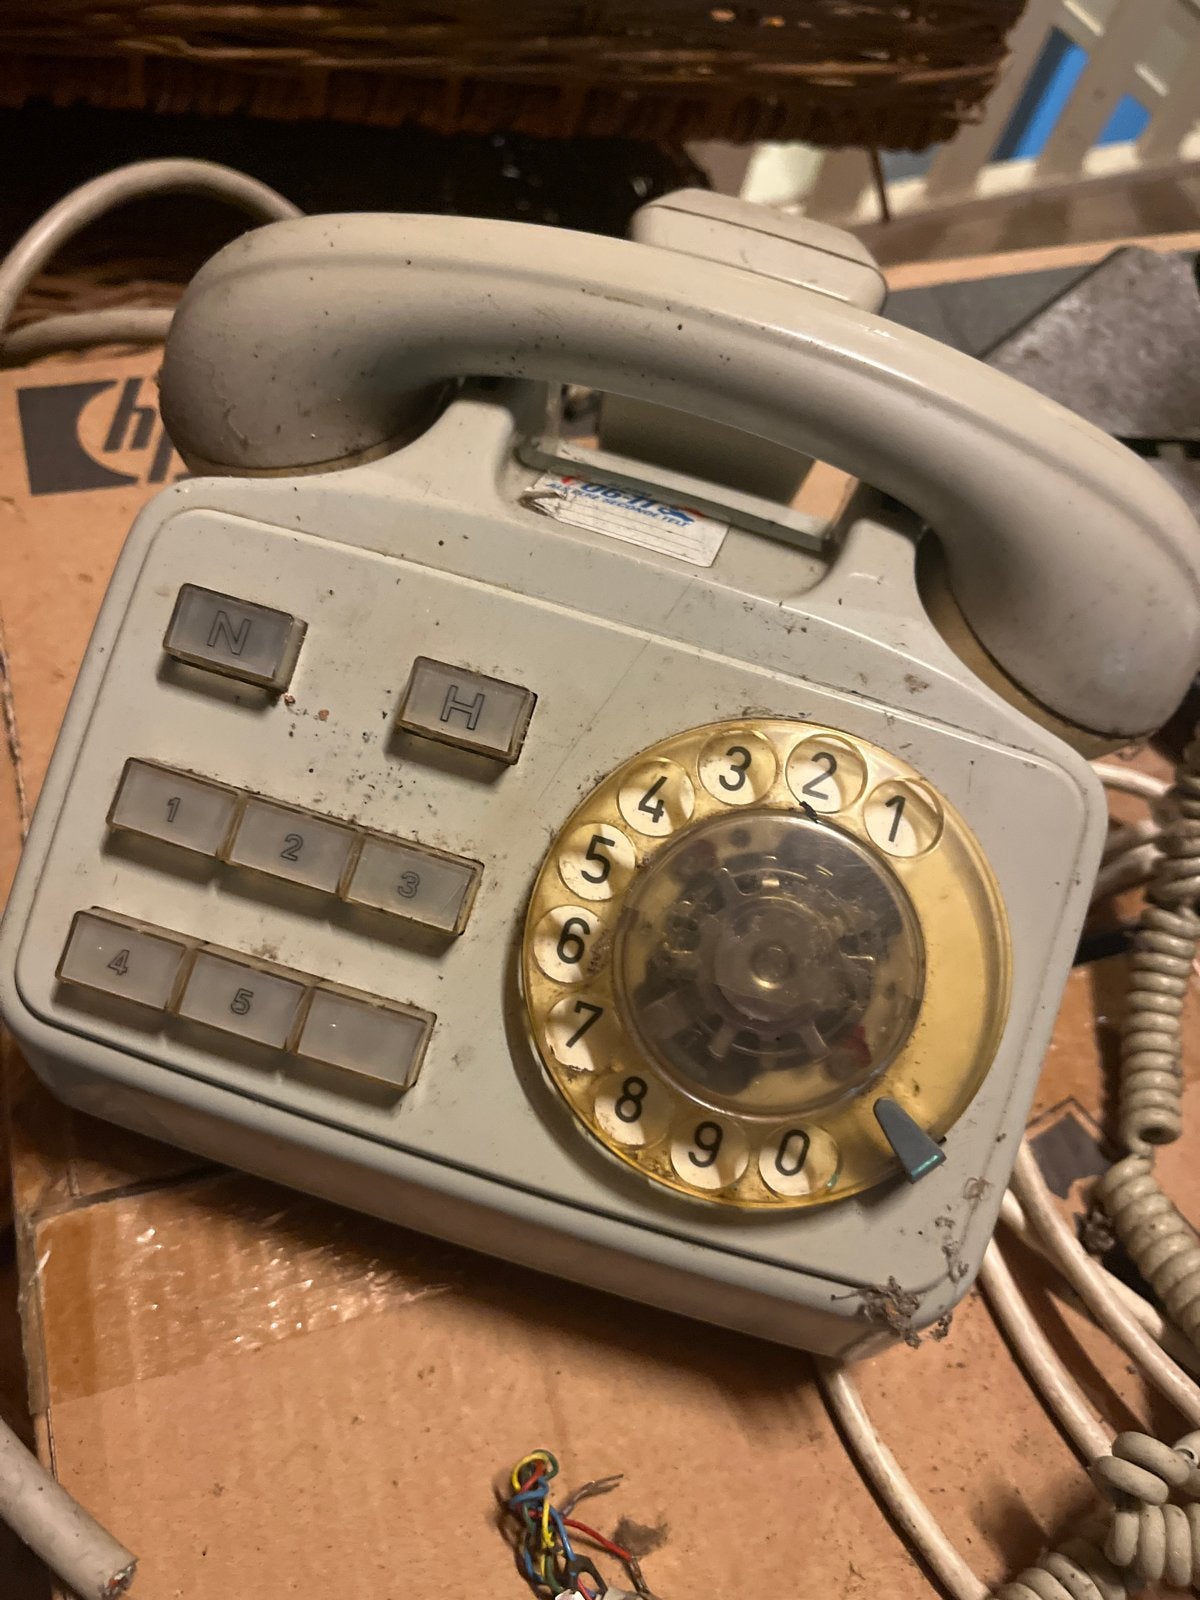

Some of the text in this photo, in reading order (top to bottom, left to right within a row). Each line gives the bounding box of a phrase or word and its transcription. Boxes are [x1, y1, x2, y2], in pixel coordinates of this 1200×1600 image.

[207, 610, 252, 656] N
[440, 684, 485, 731] H
[719, 746, 752, 792] 3
[802, 752, 838, 800] 2
[166, 797, 182, 822] 1
[638, 776, 668, 824] 4
[885, 795, 907, 844] 1
[280, 833, 304, 862] 2
[581, 834, 616, 884] 5
[397, 871, 421, 899] 3
[108, 949, 130, 976] 4
[556, 917, 591, 964] 6
[230, 988, 254, 1016] 5
[566, 1000, 604, 1048] 7
[614, 1076, 648, 1123] 8
[688, 1121, 724, 1168] 9
[774, 1129, 811, 1176] 0
